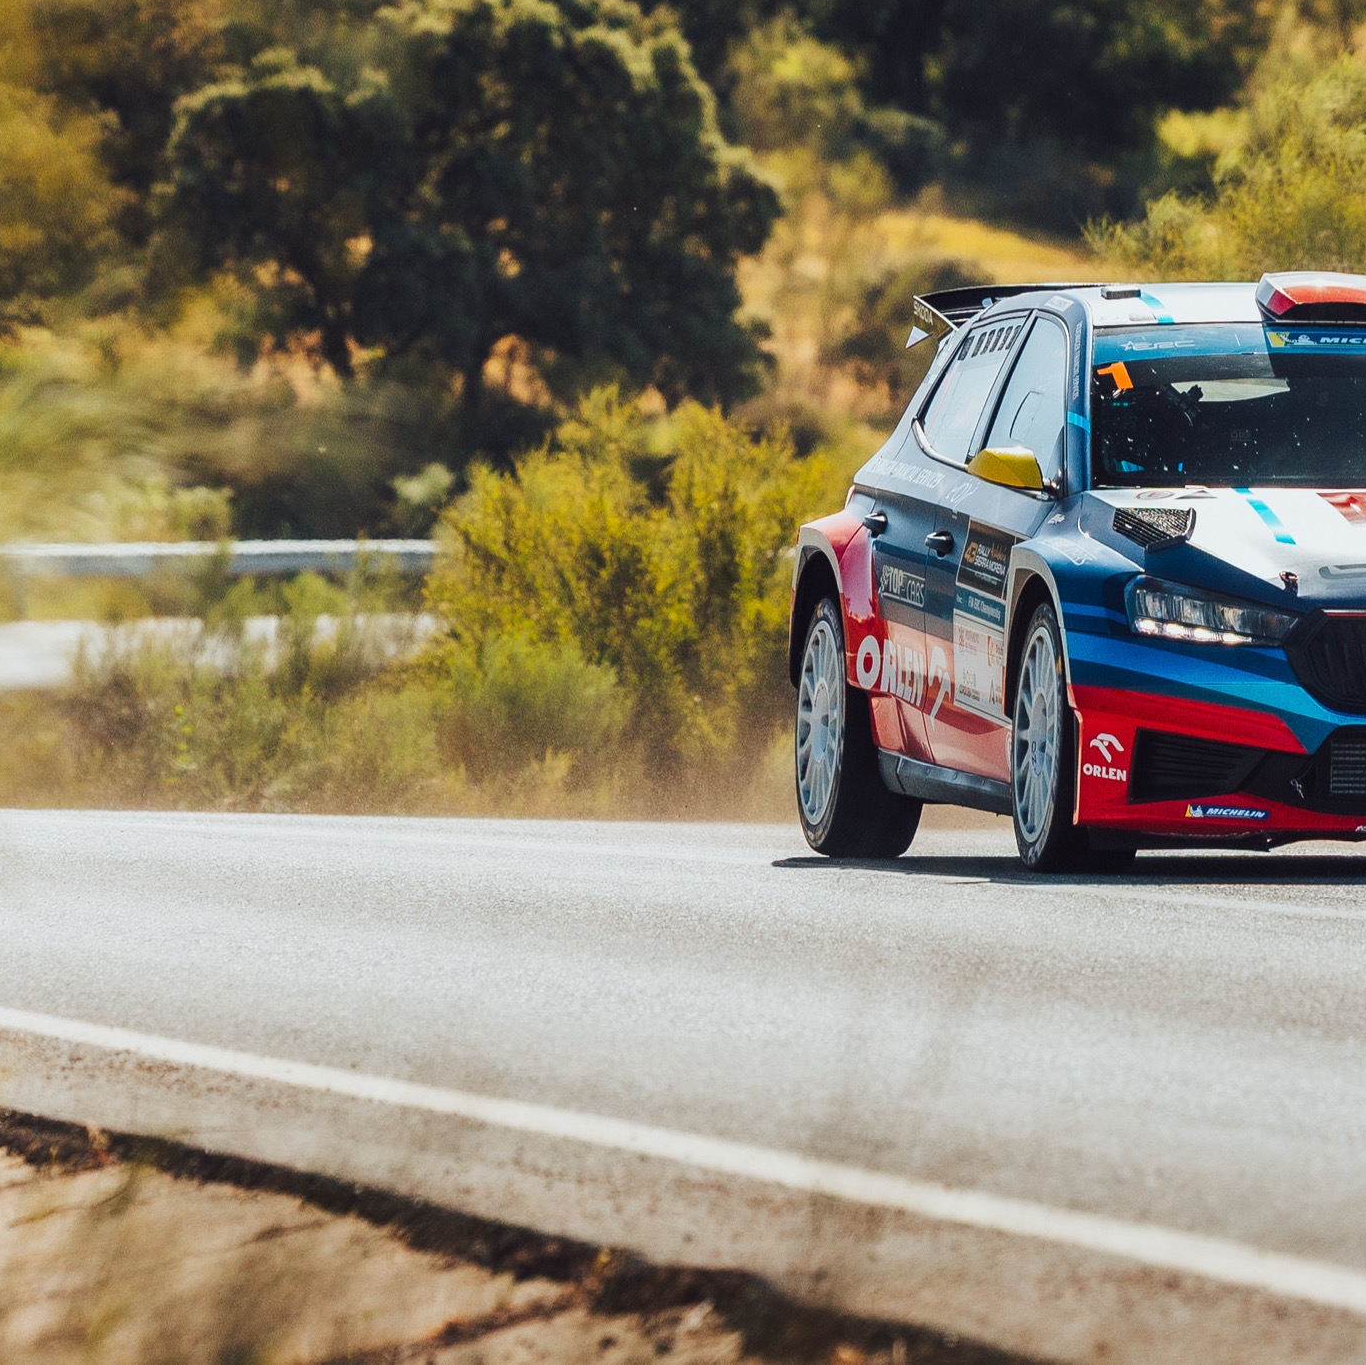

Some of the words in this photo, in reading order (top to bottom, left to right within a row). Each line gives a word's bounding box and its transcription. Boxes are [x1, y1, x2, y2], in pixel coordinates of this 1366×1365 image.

[1097, 361, 1133, 390] 1
[856, 635, 924, 706] ORLEN
[1082, 763, 1127, 782] ORLEN
[1206, 807, 1266, 818] MICHELIN
